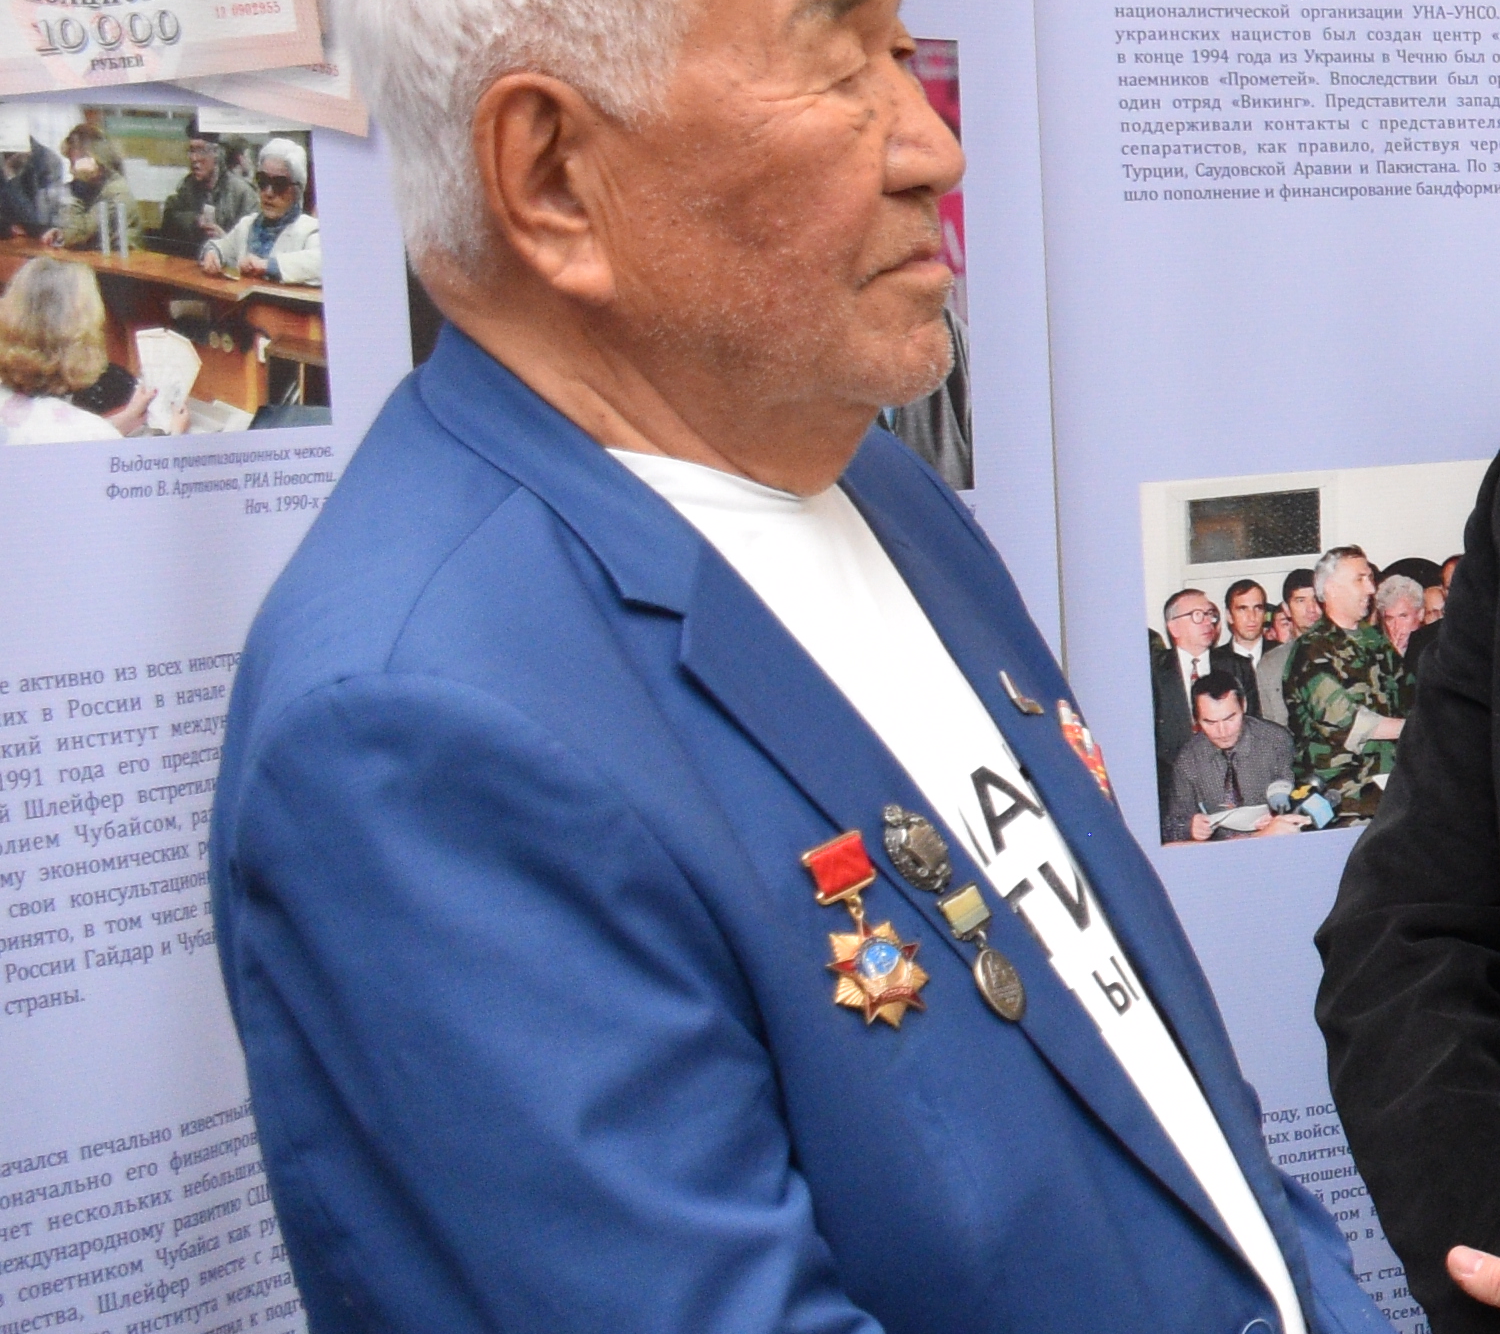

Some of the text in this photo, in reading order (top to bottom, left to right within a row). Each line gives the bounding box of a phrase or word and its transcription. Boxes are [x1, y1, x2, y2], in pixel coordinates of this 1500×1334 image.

[90, 55, 143, 71] РУБЛЕЙ
[1123, 188, 1159, 203] шло
[1163, 187, 1261, 201] пополнение
[1264, 186, 1275, 200] и
[1278, 182, 1412, 203] финансирование
[109, 453, 170, 475] Выдача
[293, 445, 335, 460] чеков.
[244, 493, 323, 516] Нач. 1990-х
[18, 658, 184, 694] активно из всех
[66, 683, 230, 720] России в начале
[23, 789, 125, 821] Шлейфер
[73, 814, 183, 849] Чубайсом,
[79, 1126, 173, 1162] печально
[1293, 1121, 1341, 1145] войск
[17, 1234, 221, 1304] советником Чубайса
[97, 1275, 191, 1316] Шлейфер
